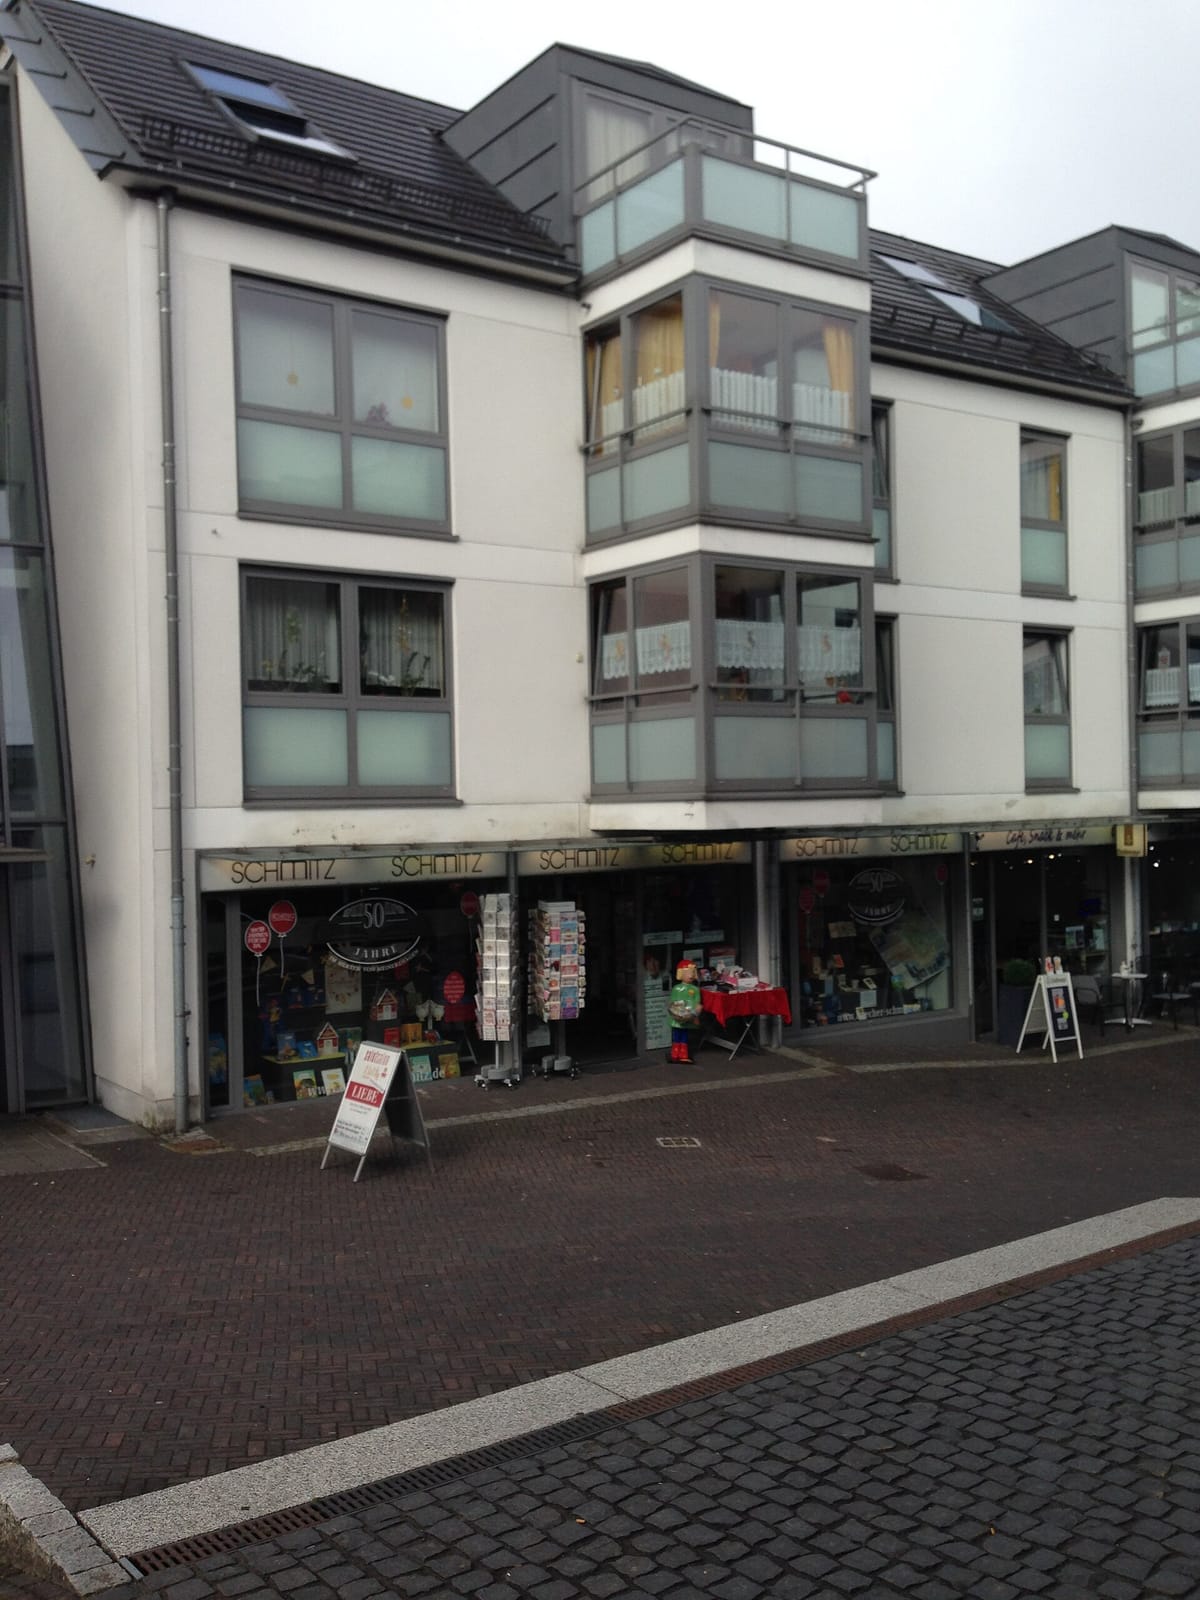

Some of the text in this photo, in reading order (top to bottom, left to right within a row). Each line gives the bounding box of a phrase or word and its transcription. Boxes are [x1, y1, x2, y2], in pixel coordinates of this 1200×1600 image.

[796, 838, 859, 857] SCHMITZ
[889, 832, 948, 853] SCHMITZ
[391, 853, 482, 877] SCHMITZ
[540, 846, 620, 870] SCHMITZ
[231, 858, 337, 884] SCHMITZ
[363, 902, 385, 929] 50
[351, 1084, 378, 1104] LIEBE
